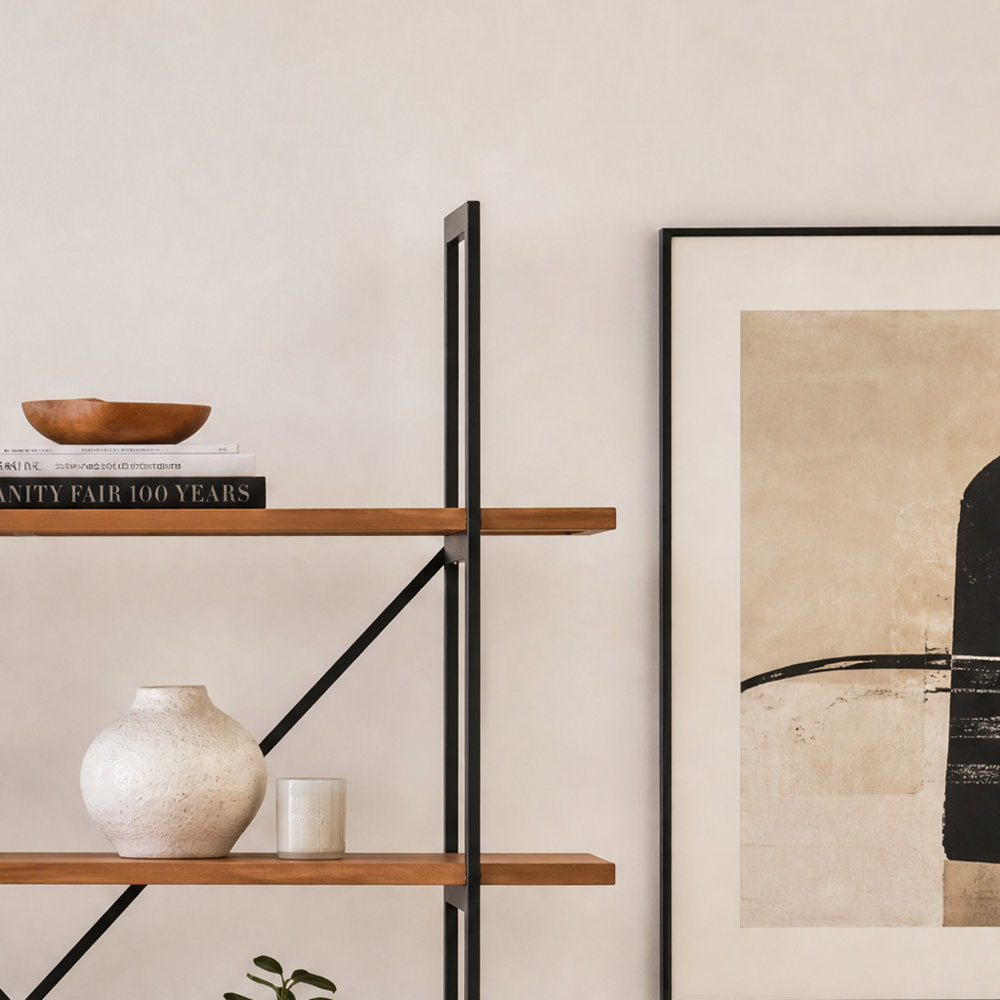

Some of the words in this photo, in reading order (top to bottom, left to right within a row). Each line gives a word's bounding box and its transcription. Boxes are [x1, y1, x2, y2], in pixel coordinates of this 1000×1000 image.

[70, 484, 122, 503] FAIR
[129, 484, 169, 503] 100
[175, 484, 251, 503] YEARS
